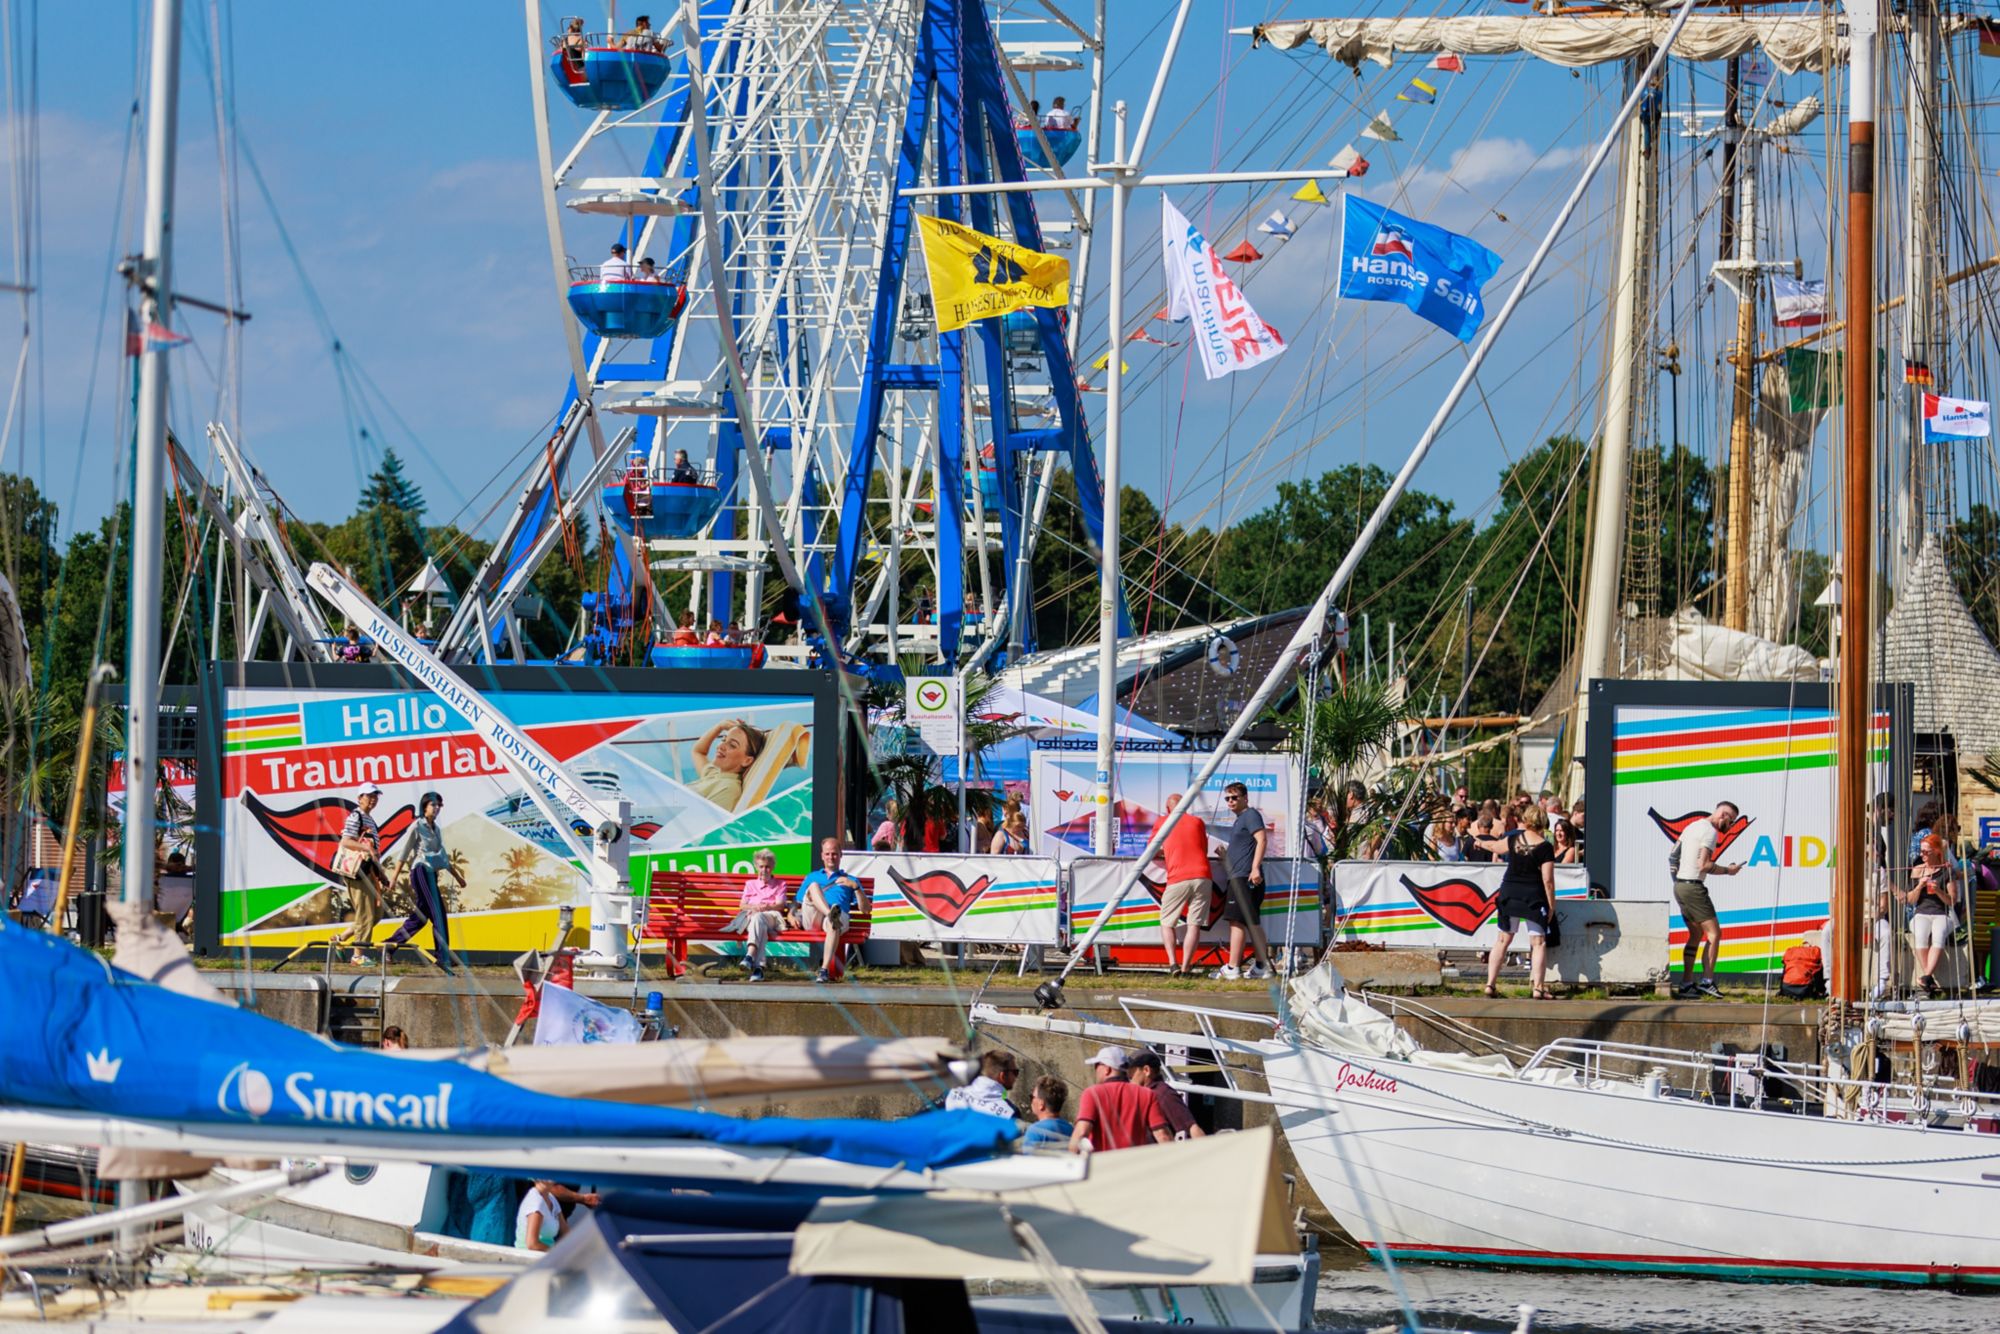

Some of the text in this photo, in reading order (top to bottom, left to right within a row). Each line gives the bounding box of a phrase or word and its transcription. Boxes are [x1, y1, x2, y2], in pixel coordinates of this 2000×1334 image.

[1352, 256, 1478, 315] Hanse Sail
[342, 697, 446, 737] Hallo
[368, 619, 560, 789] MUSEUMSHAFEN ROSTOCK
[262, 741, 504, 790] Traumurlau
[1245, 779, 1272, 787] AIDA
[285, 1072, 453, 1129] Sunsail
[1336, 1063, 1397, 1093] Joshua
